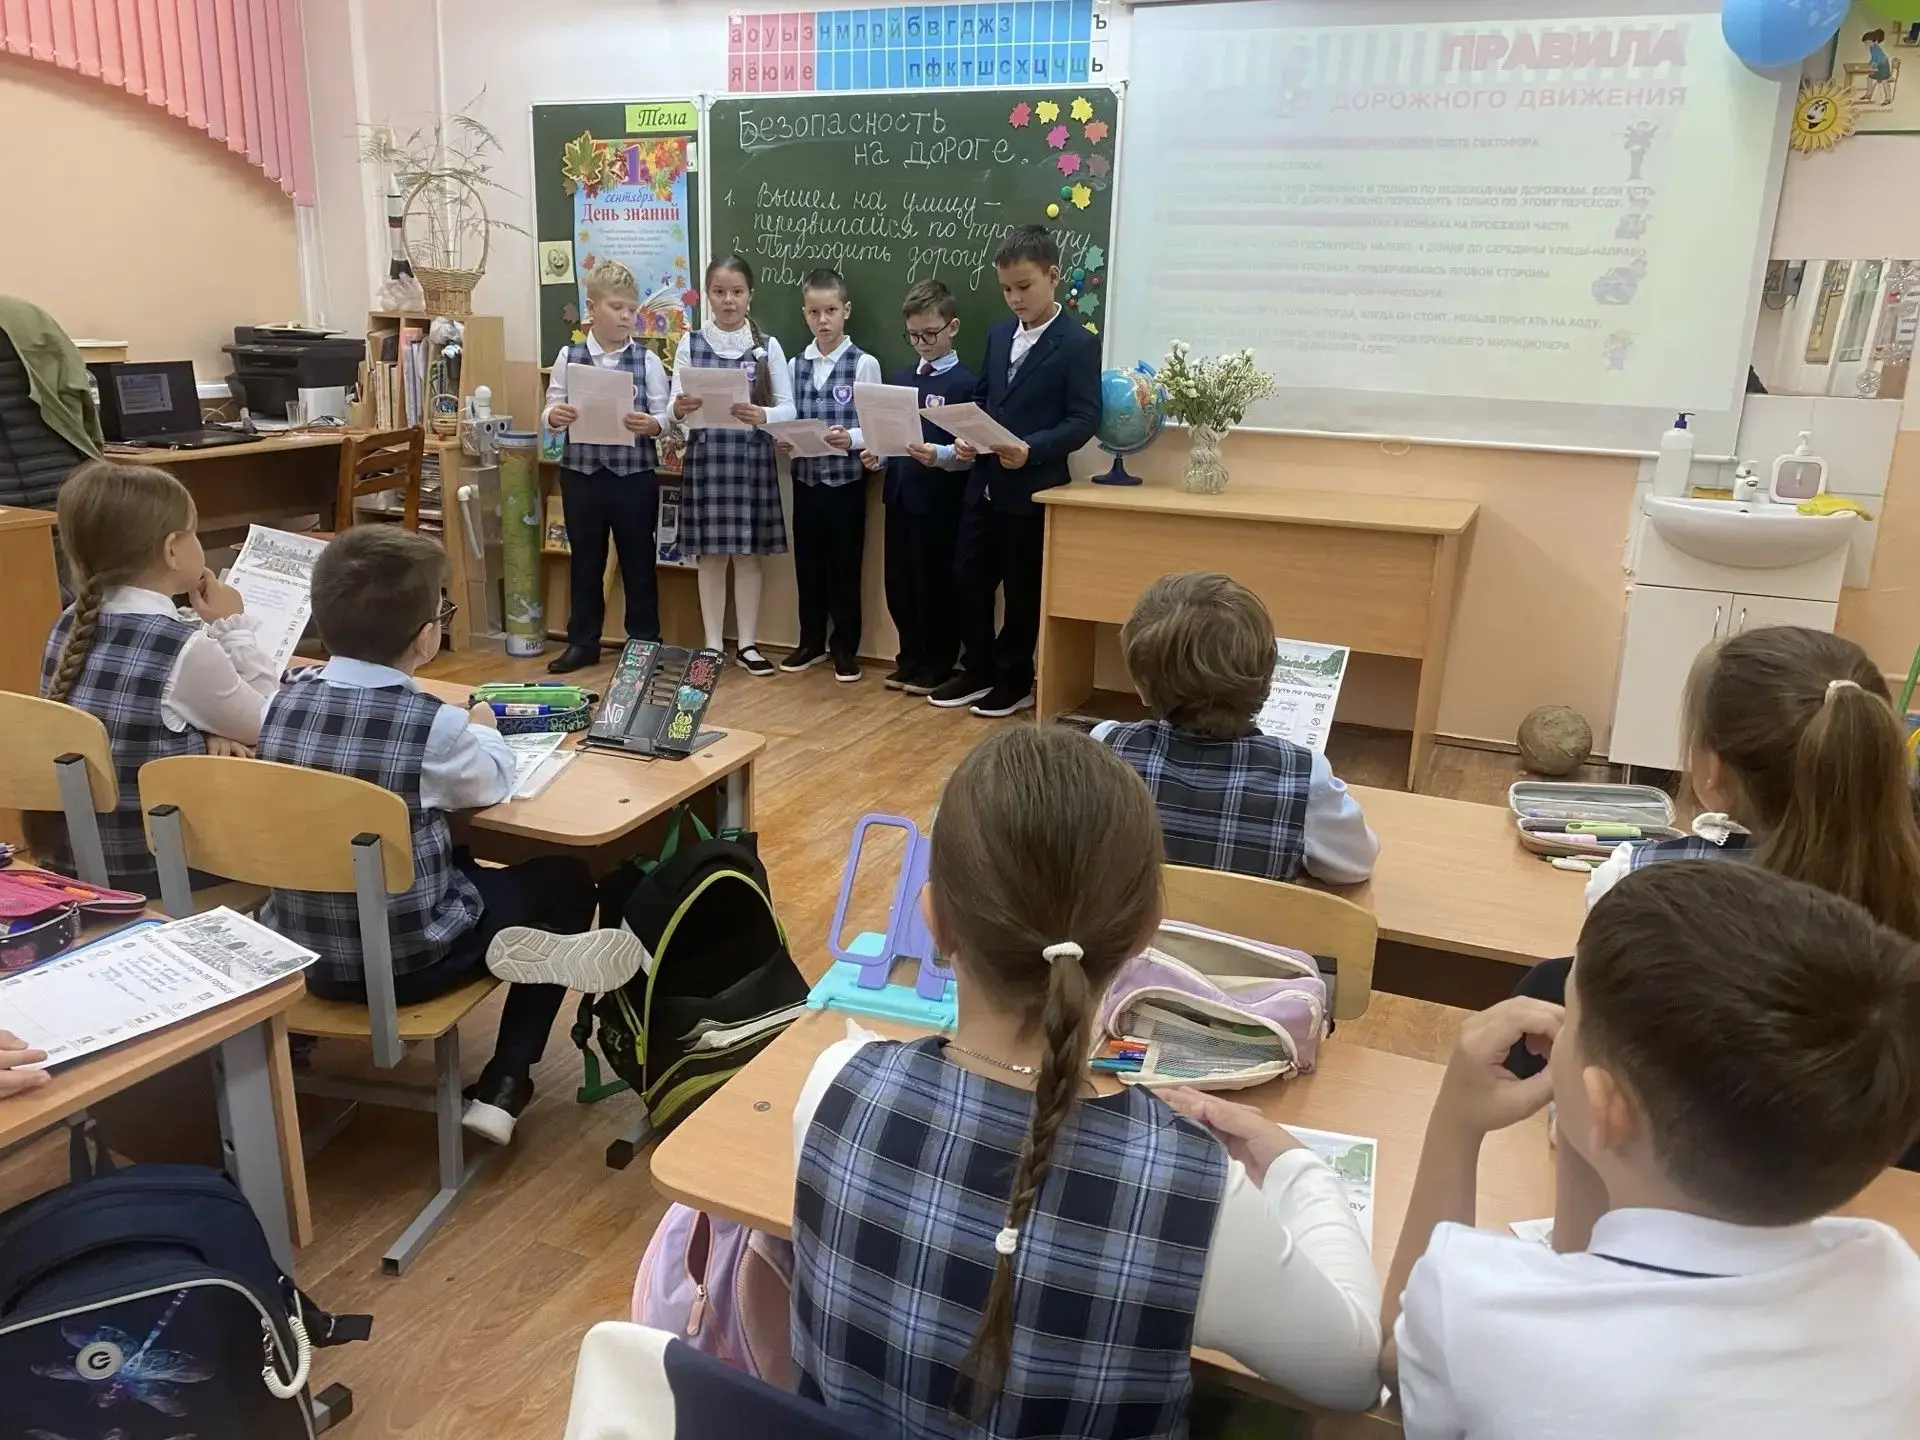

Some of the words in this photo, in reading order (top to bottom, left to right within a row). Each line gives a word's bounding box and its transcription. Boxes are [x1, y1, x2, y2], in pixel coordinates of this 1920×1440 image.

[1440, 29, 1687, 71] ПРАВИЛА
[1331, 90, 1507, 113] ДОРОЖНОГО
[1515, 86, 1688, 112] ДВИЖЕНИЯ
[638, 109, 687, 127] Тема
[739, 108, 946, 149] Безопасность
[854, 141, 890, 166] на
[605, 186, 654, 208] сентября
[757, 181, 841, 211] Вышел
[853, 190, 887, 210] на
[581, 203, 619, 225] День
[624, 203, 680, 221] знаний
[928, 220, 956, 238] по
[1303, 690, 1333, 701] городу
